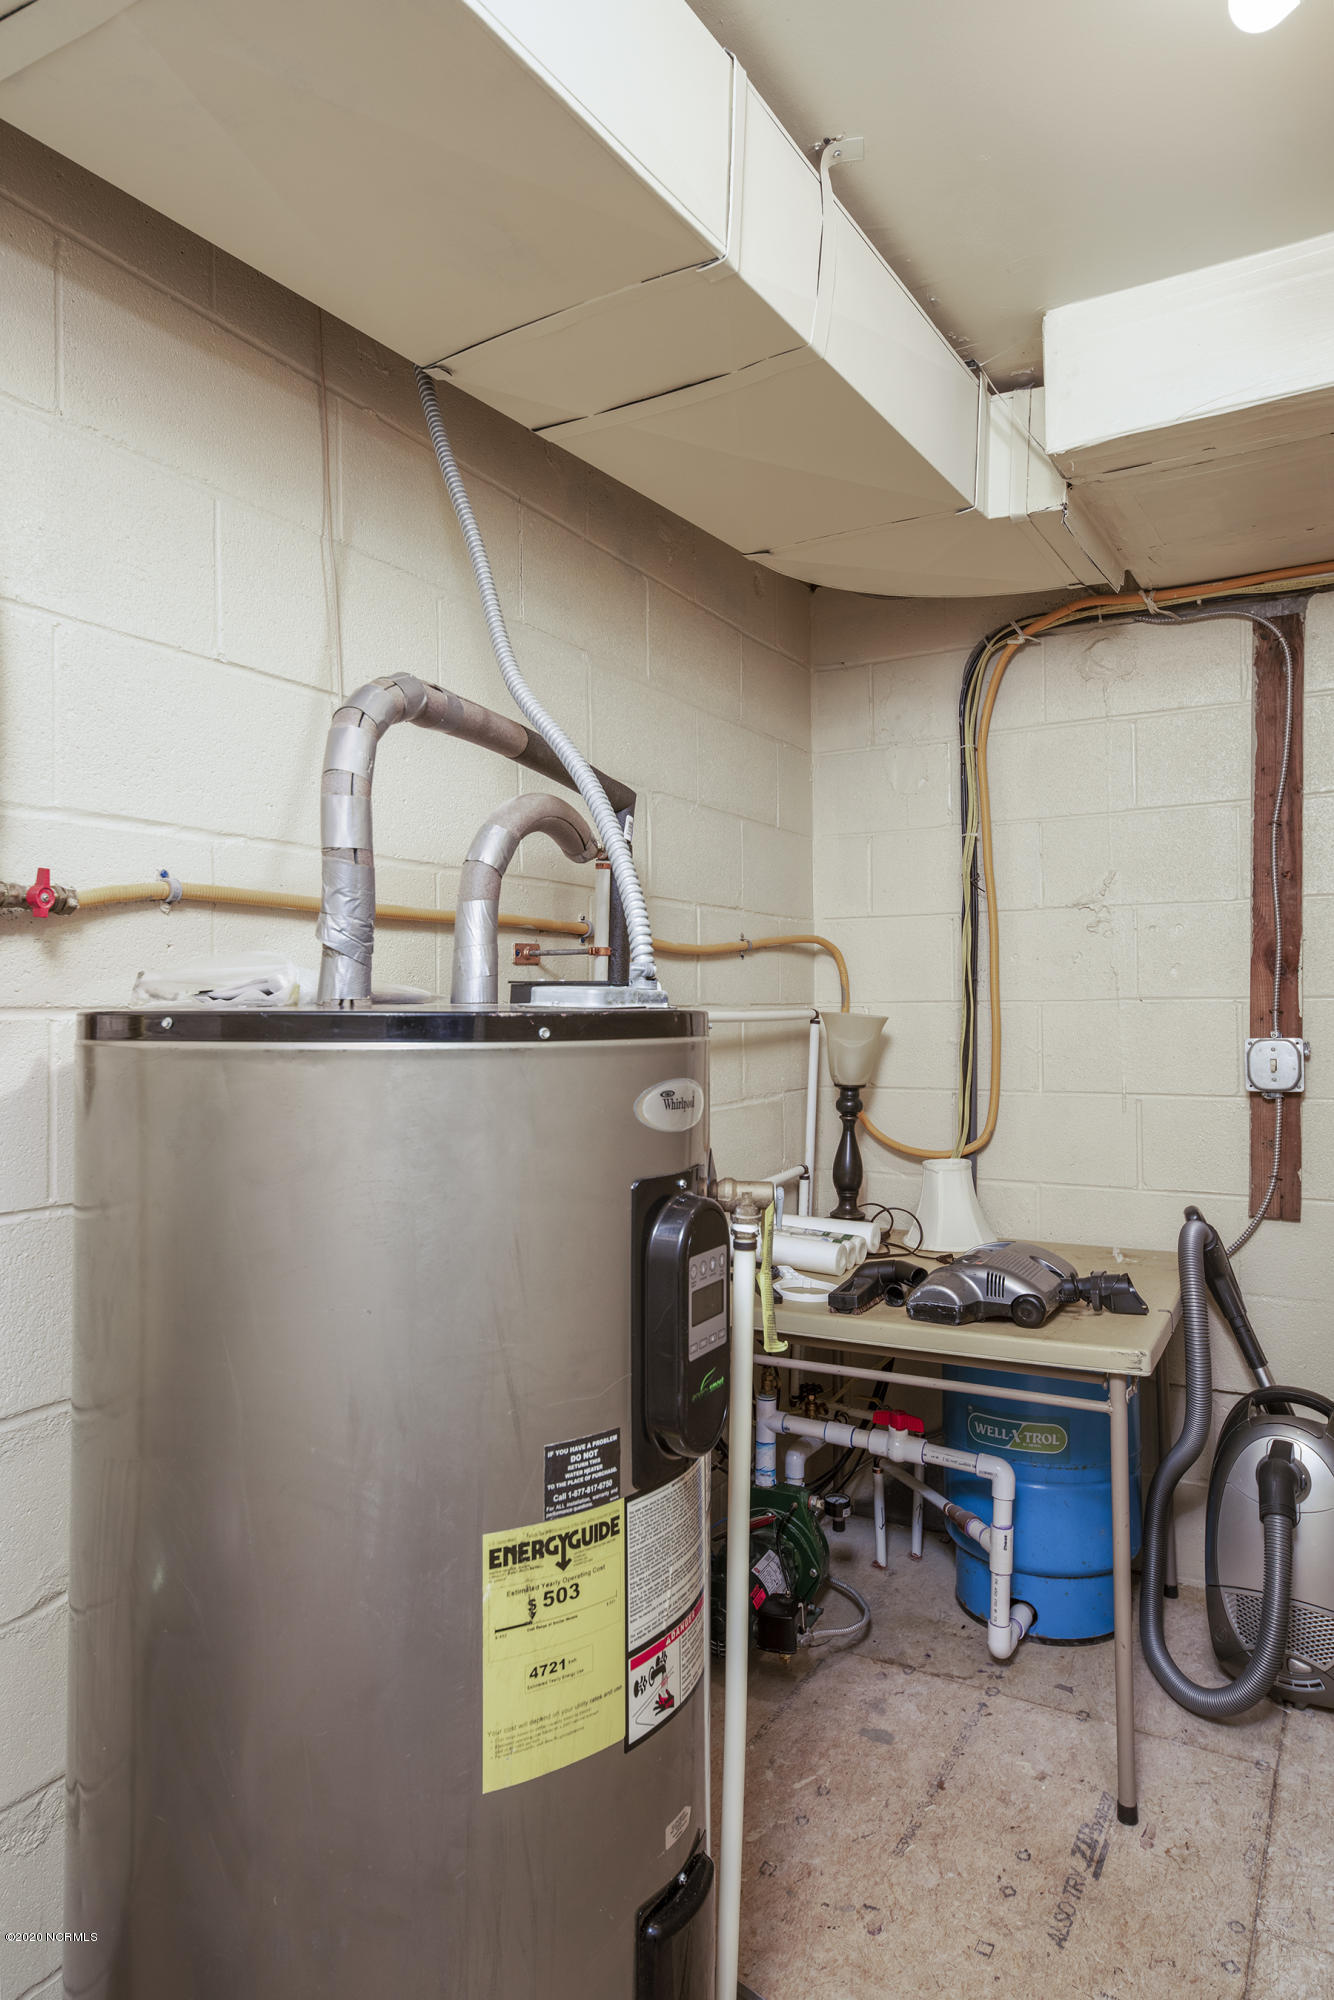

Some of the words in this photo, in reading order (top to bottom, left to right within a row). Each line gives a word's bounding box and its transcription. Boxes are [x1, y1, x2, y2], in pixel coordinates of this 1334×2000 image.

[555, 1447, 569, 1456] YOU
[569, 1443, 586, 1453] HAVE
[592, 1434, 618, 1447] PROBLEM
[567, 1461, 589, 1471] RETURN
[589, 1457, 601, 1465] THIS
[570, 1453, 581, 1463] DO
[583, 1449, 599, 1459] NOT
[565, 1469, 583, 1479] WATER
[583, 1464, 603, 1475] HEATER
[567, 1476, 584, 1486] PLACE
[553, 1492, 567, 1502] Call
[541, 1579, 561, 1590] Yearly
[562, 1570, 592, 1584] Operating
[592, 1564, 606, 1573] Cost
[543, 1582, 580, 1608] 503
[529, 1658, 566, 1679] 4721
[589, 1693, 603, 1704] rates
[603, 1688, 613, 1698] and
[1062, 1867, 1087, 1900] TRY
[1048, 1901, 1077, 1950] ALSO
